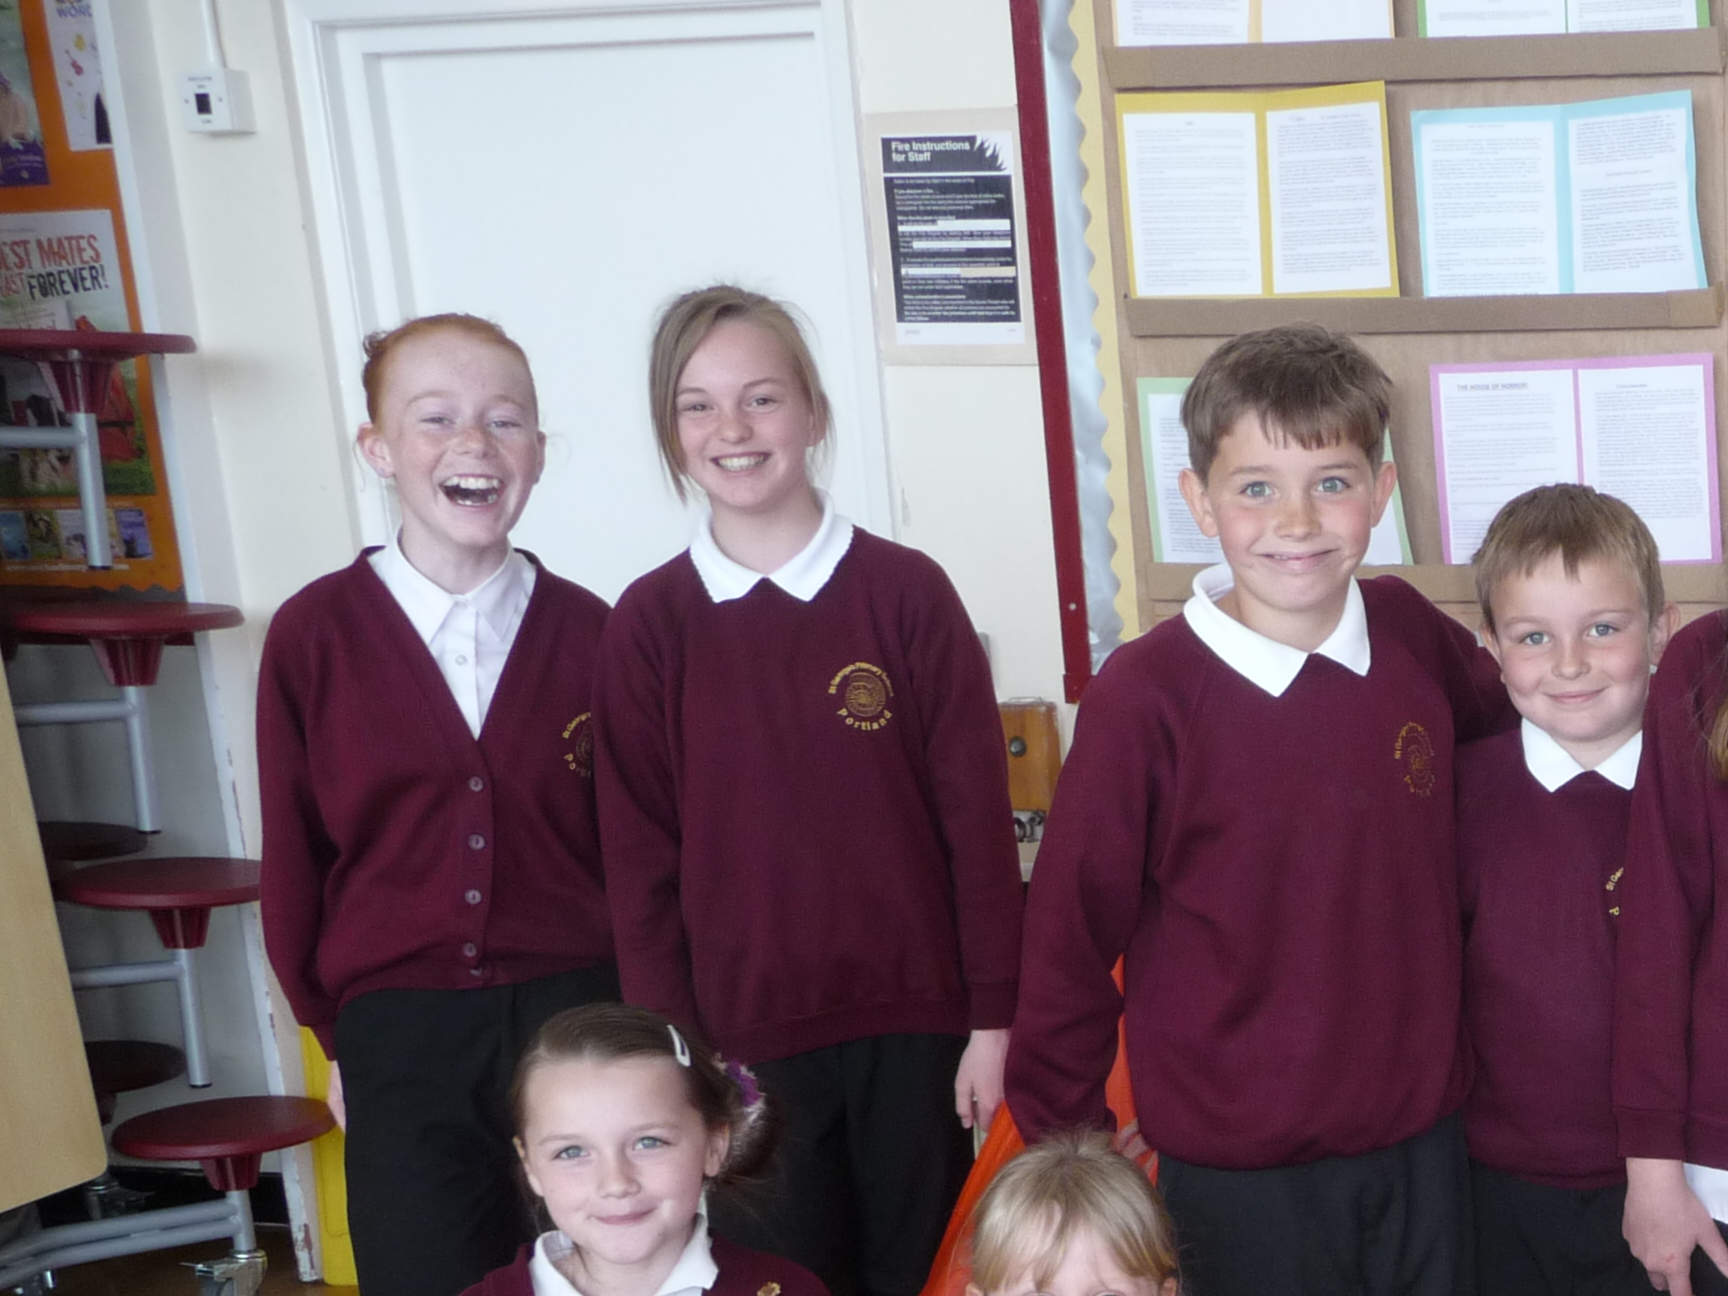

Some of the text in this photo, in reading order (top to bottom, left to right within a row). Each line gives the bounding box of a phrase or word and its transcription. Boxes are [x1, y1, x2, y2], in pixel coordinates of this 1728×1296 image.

[891, 140, 970, 152] Fire Instructions
[892, 151, 931, 162] for Staff
[36, 234, 101, 269] MATES
[27, 264, 109, 301] FOREVER!
